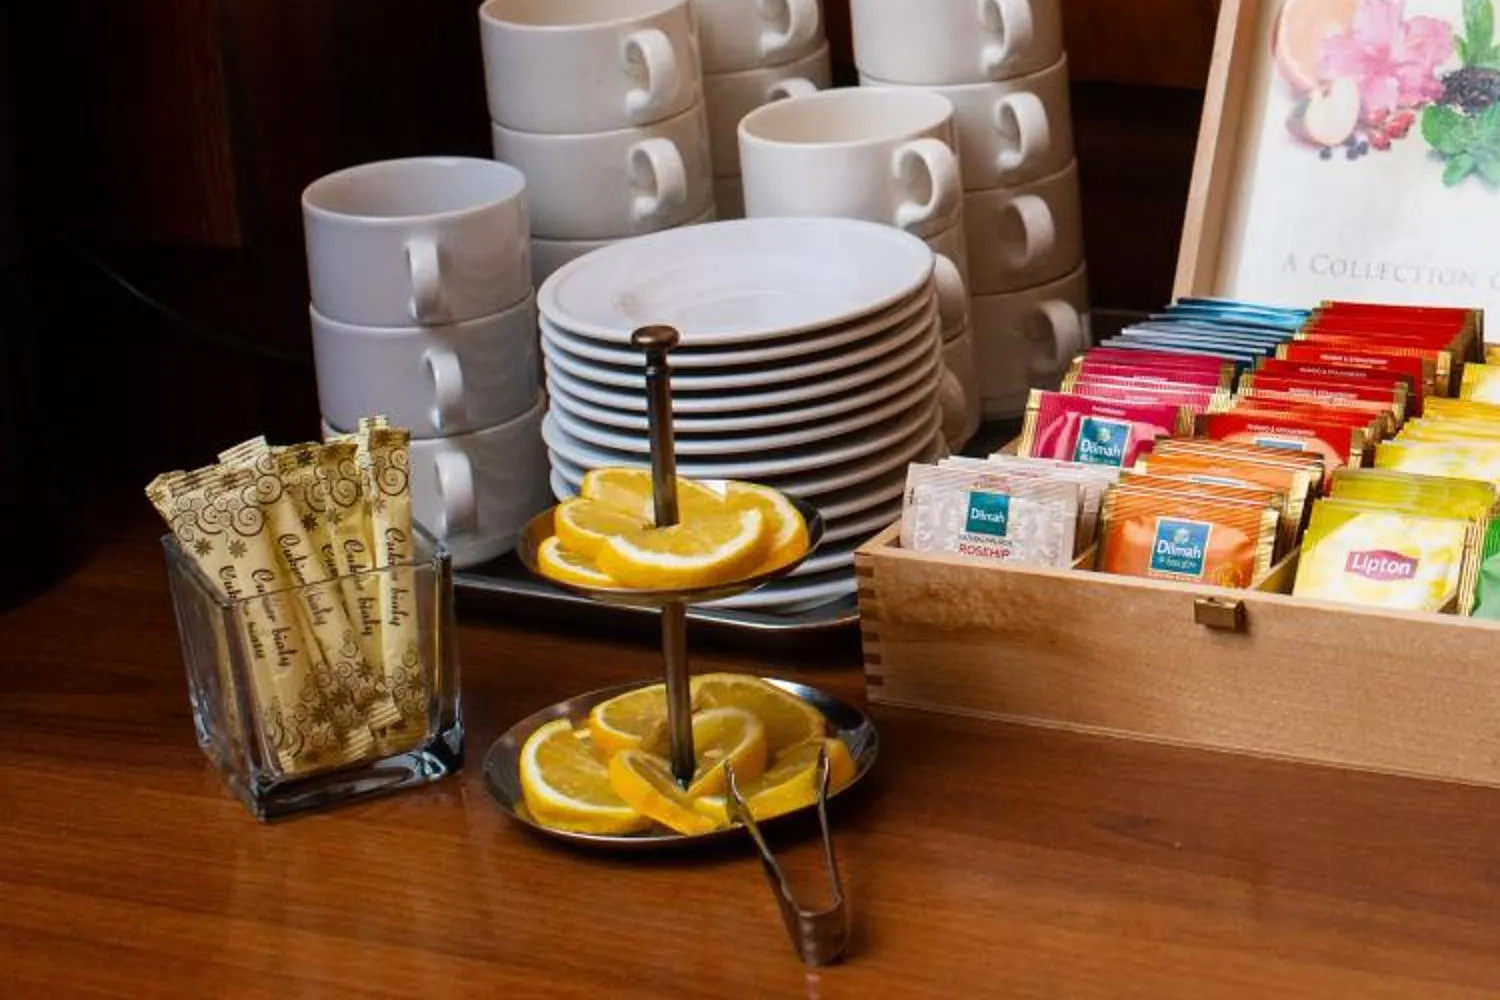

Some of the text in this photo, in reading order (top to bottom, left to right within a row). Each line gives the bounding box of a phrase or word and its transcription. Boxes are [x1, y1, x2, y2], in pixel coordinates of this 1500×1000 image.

[1281, 252, 1297, 274] A
[1081, 438, 1121, 458] Dilmah
[970, 507, 1005, 523] Dilmah
[960, 543, 1011, 559] ROSEHIP
[1157, 539, 1202, 559] Dilmah
[1352, 554, 1412, 576] Lipton
